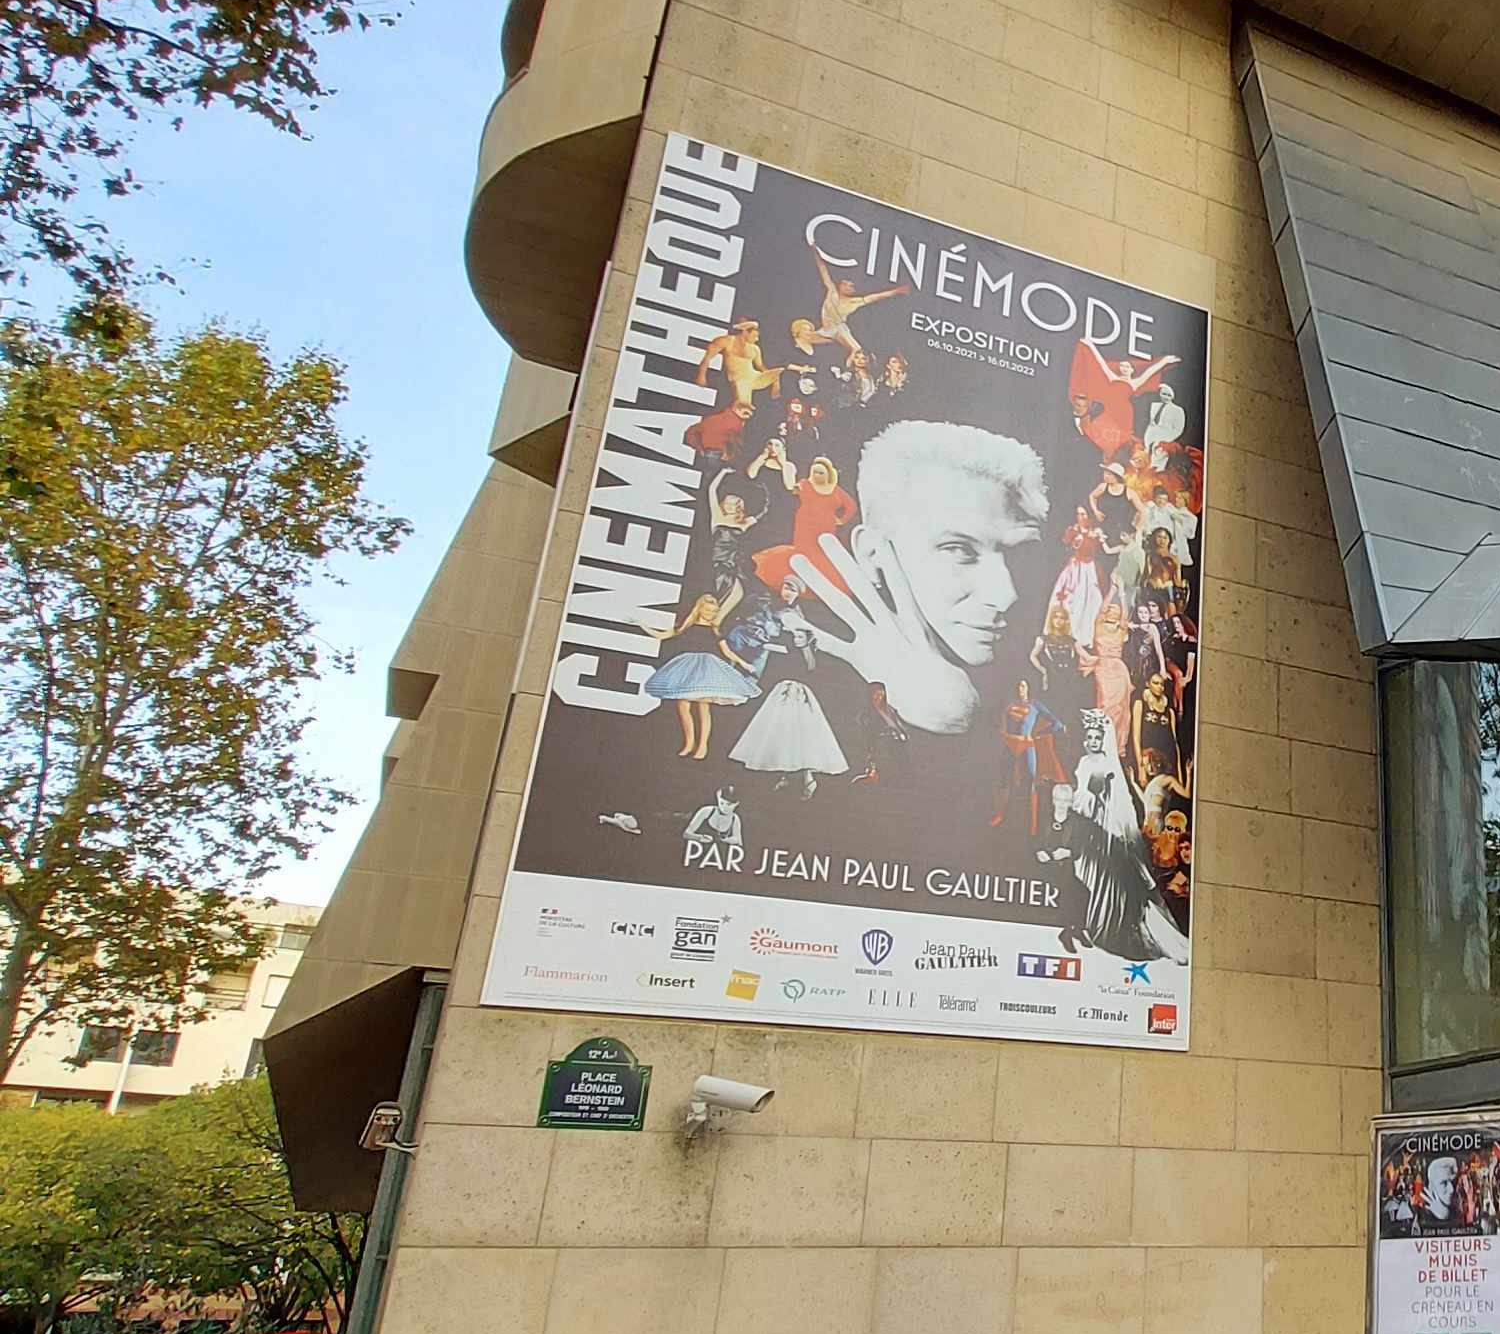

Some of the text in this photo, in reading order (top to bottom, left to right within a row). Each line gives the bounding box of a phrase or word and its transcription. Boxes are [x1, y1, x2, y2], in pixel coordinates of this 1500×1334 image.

[805, 214, 1155, 360] CINÉMODE
[911, 312, 1049, 367] EXPOSITION
[927, 338, 977, 359] 06.10.2021
[987, 355, 1035, 376] 16.01.2022
[683, 840, 1060, 908] PAR JEAN PAUL GAULTIER
[610, 922, 656, 937] CNC
[675, 919, 719, 930] Fondation
[674, 931, 716, 947] gan
[759, 937, 839, 954] Gaumont
[922, 939, 991, 960] Jean Paul
[915, 955, 999, 970] GAULTIER
[1021, 956, 1077, 979] TF1
[524, 965, 608, 983] Flammarion
[649, 973, 696, 988] Insert
[730, 973, 760, 986] fnac
[810, 987, 846, 996] RATP
[868, 988, 918, 1008] ELLE
[1000, 1002, 1057, 1015] TROISCOULEURS
[1077, 1007, 1129, 1022] Le Monde
[581, 1072, 617, 1082] PLACE
[571, 1082, 623, 1094] LÉONARD
[565, 1095, 625, 1106] BERNSTEIN
[1406, 1133, 1481, 1153] CINÉMODE
[1415, 1238, 1492, 1254] VISITEURS
[1429, 1253, 1477, 1267] MUNIS
[1418, 1268, 1487, 1283] DE BILLET
[1425, 1285, 1480, 1298] POUR LE
[1411, 1298, 1494, 1314] CRÉNEAU EN
[1428, 1316, 1477, 1328] COURS
